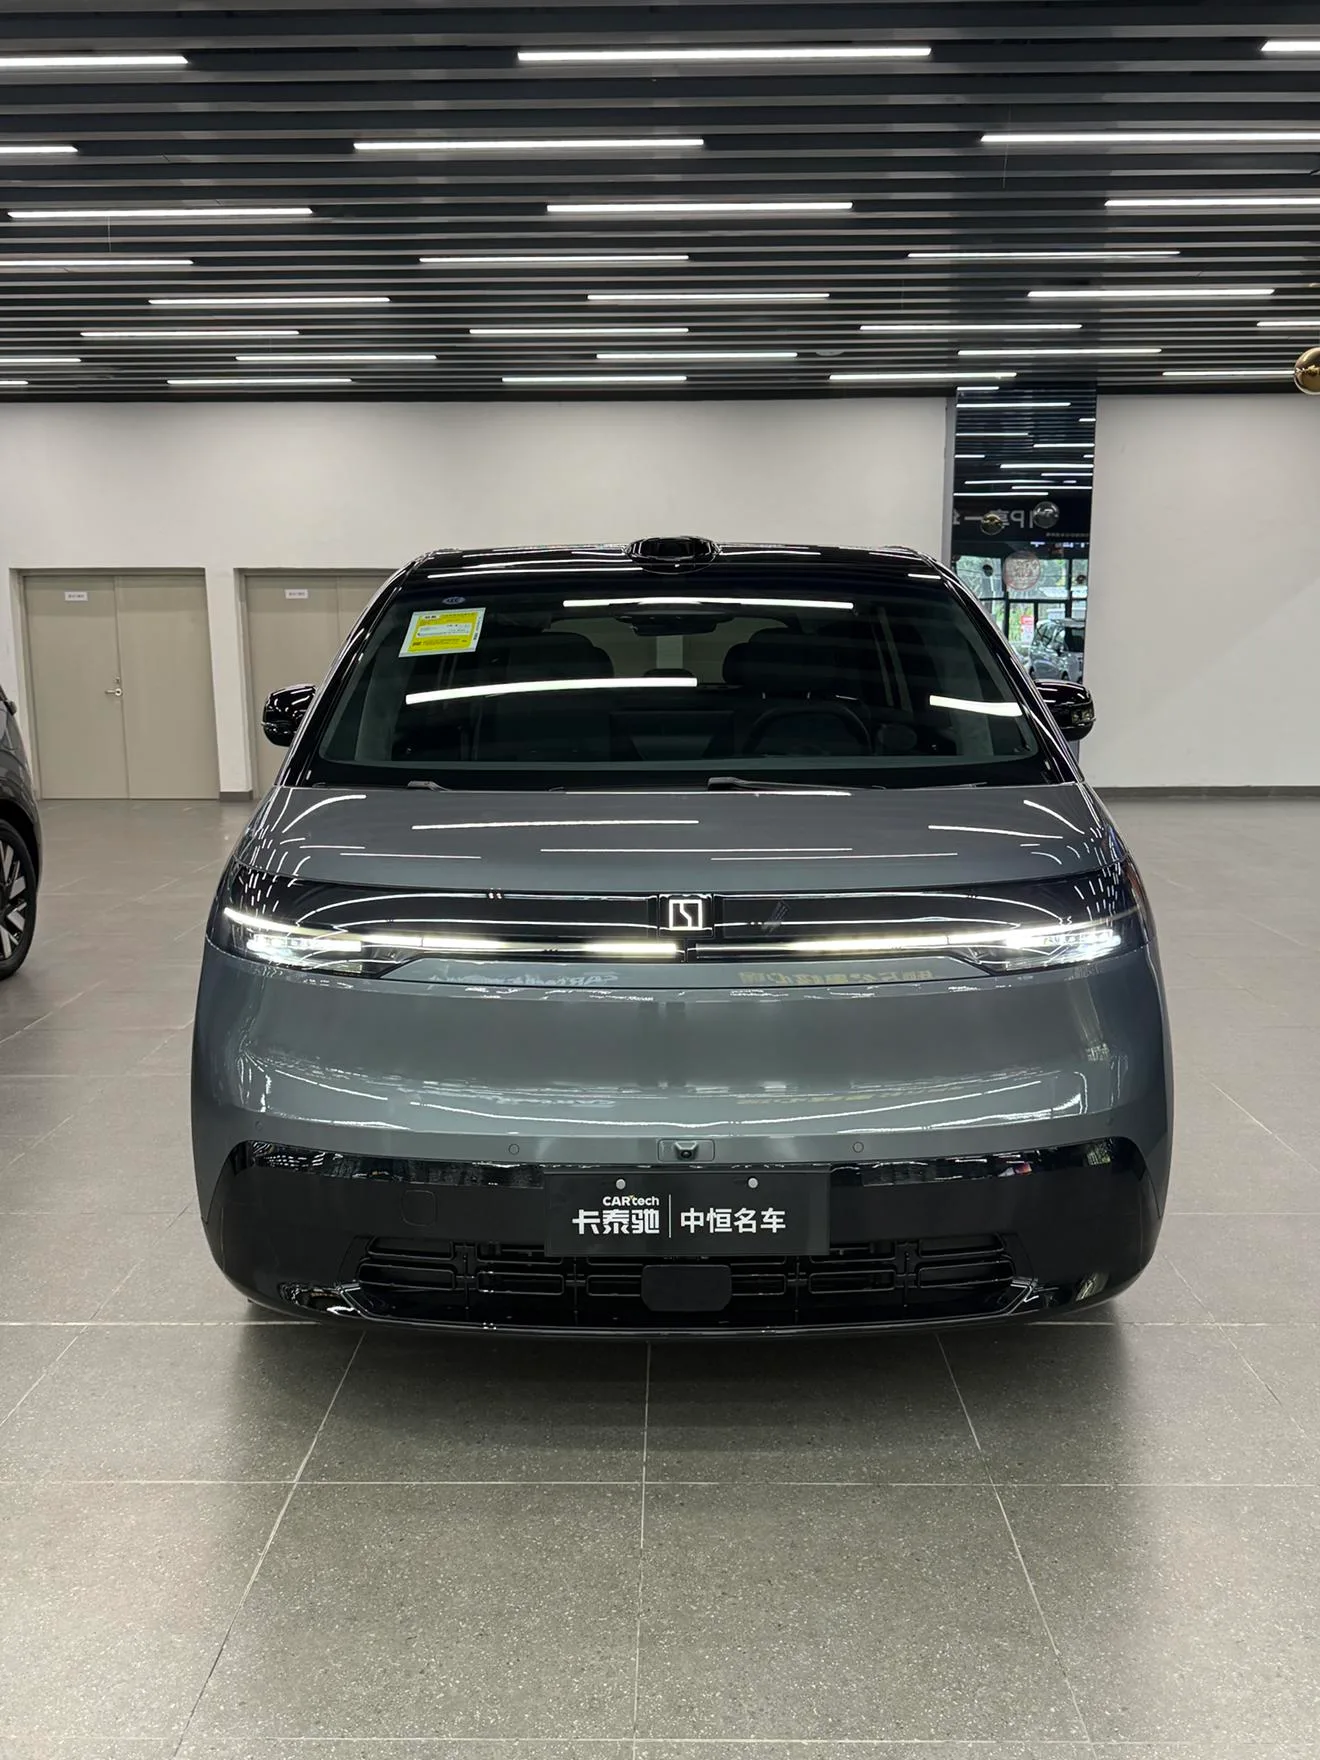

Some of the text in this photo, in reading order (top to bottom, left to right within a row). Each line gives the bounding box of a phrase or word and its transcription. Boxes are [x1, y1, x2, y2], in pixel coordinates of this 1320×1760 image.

[602, 1195, 660, 1206] CARtech
[572, 1207, 786, 1235] 卡泰驰 中恒名车
